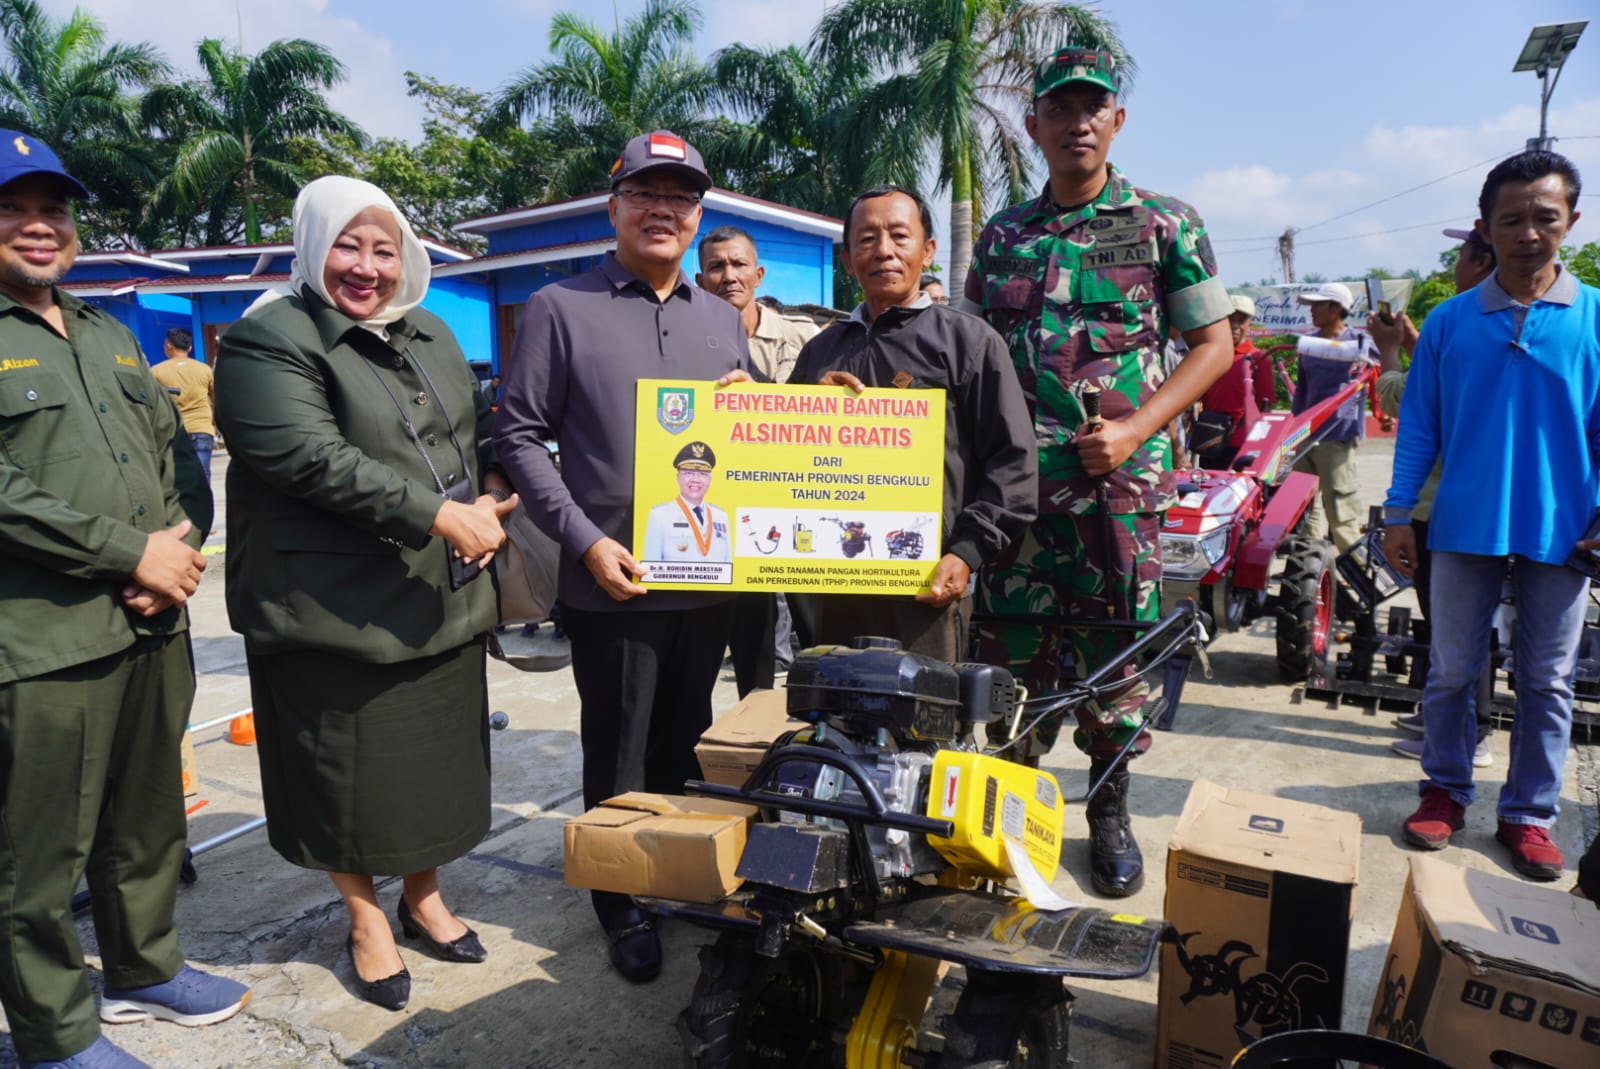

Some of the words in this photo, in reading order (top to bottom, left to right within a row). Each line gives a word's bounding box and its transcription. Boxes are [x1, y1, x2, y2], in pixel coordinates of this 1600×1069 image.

[1088, 251, 1115, 266] TNI
[1124, 248, 1146, 261] AD
[1252, 315, 1307, 325] NERIMA
[713, 393, 838, 415] PENYERAHAN
[842, 397, 929, 418] BANTUAN
[730, 422, 833, 446] ALSINTAN
[837, 425, 913, 448] GRATIS
[813, 456, 842, 468] DARI
[726, 470, 804, 483] PEMERINTAH
[808, 473, 864, 485] PROVINSI
[867, 474, 930, 487] BENGKULU
[791, 488, 831, 500] TAHUN
[834, 490, 865, 502] 2024
[759, 566, 784, 574] DINAS
[787, 567, 826, 575] TANAMAN
[827, 568, 860, 576] PANGAN
[862, 568, 920, 577] HORTIKULTURA
[746, 577, 765, 585] DAN
[766, 577, 820, 586] PERKEBUNAN
[822, 578, 848, 587] (TPHP)
[850, 579, 887, 587] PROVINSI
[888, 580, 930, 588] BENGKULU
